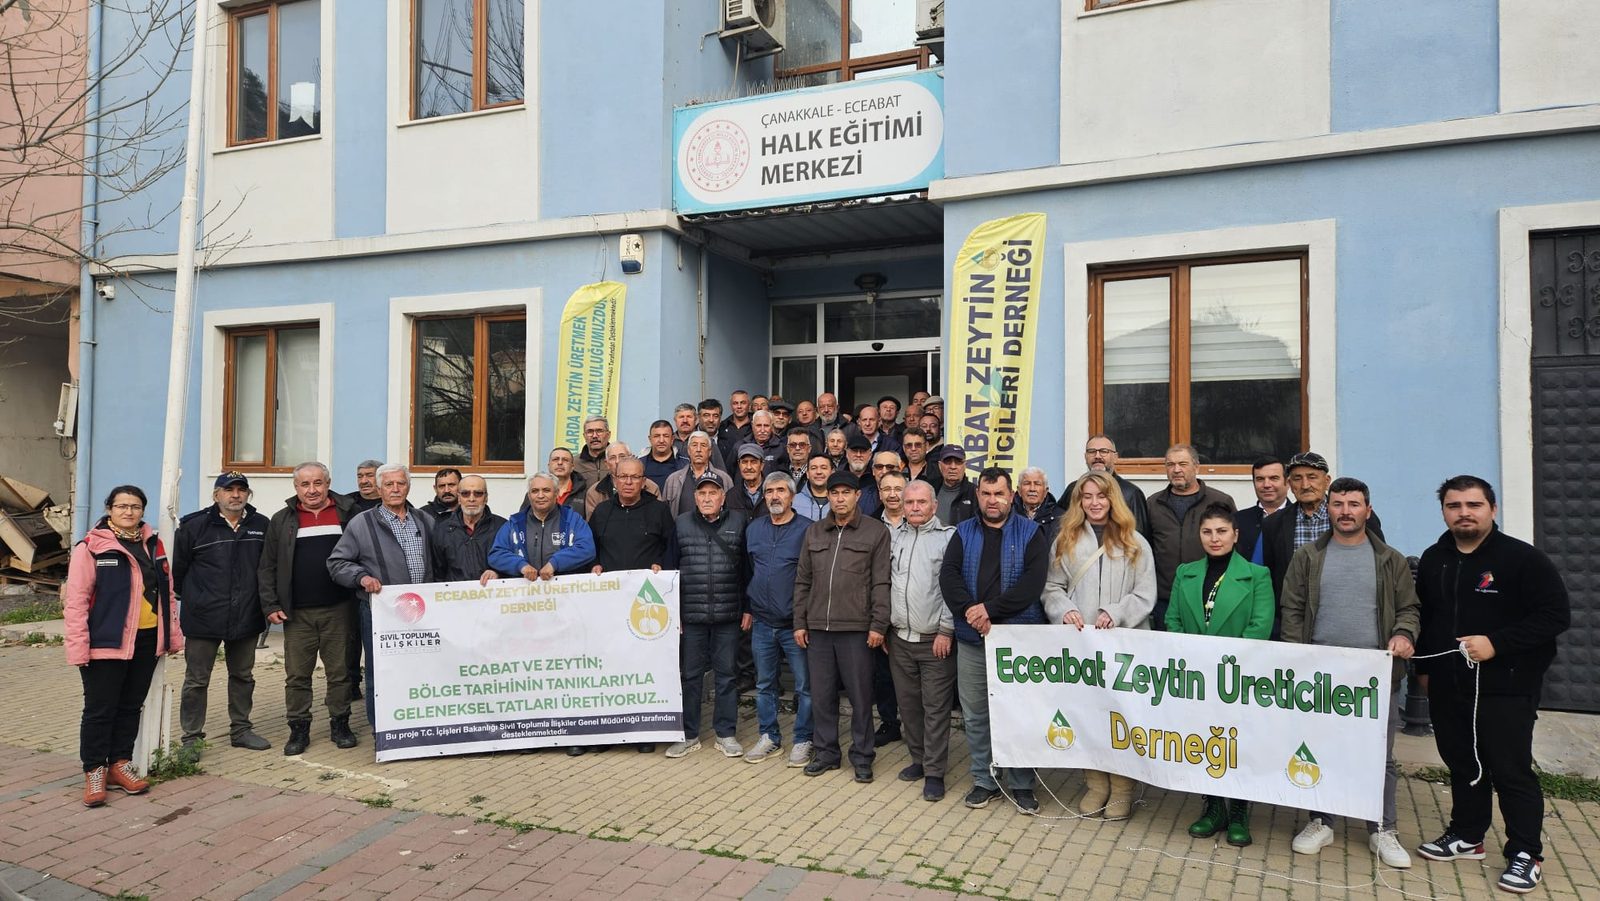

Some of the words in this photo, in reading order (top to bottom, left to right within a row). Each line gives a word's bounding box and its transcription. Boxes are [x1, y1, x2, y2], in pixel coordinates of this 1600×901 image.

[761, 104, 834, 128] ÇANAKKALE
[844, 94, 902, 115] ECEABAT
[761, 129, 823, 156] HALK
[829, 110, 922, 148] EĞİTİMİ
[761, 149, 862, 185] MERKEZİ
[1001, 239, 1033, 356] DERNEĞİ
[568, 315, 587, 369] ÜRETMEK
[963, 274, 995, 386] ZEYTİN
[587, 298, 607, 417] ORUMLULUĞUMUZDU
[566, 372, 583, 413] ZEYTİN
[566, 415, 580, 454] LARDA
[434, 588, 495, 602] ECEABAT
[495, 583, 541, 598] ZEYTİN
[543, 577, 620, 595] ÜRETİCİLERİ
[500, 598, 557, 614] DERNEĞİ
[380, 639, 441, 649] İLİŞKİLER
[401, 632, 440, 640] TOPLUMLA
[459, 661, 520, 677] ECABAT
[522, 658, 543, 672] VE
[545, 654, 603, 671] ZEYTİN;
[995, 647, 1106, 688] Eceabat
[1112, 653, 1205, 706] Zeytin
[1217, 654, 1379, 719] Üreticileri
[409, 683, 461, 700] BÖLGE
[464, 676, 543, 696] TARİHİNİN
[546, 672, 655, 690] TANIKLARIYLA
[393, 702, 494, 721] GELENEKSEL
[496, 698, 558, 714] TATLARI
[562, 692, 669, 709] ÜRETİYORUZ...
[385, 732, 397, 741] Bu
[398, 731, 419, 741] proje
[420, 728, 435, 737] T.C.
[436, 727, 461, 737] İçişleri
[463, 725, 498, 734] Bakanlığı
[499, 722, 516, 731] Sivil
[516, 719, 550, 730] Toplumla
[550, 718, 577, 729] İlişkiler
[578, 719, 599, 727] Genel
[601, 716, 640, 726] Müdürlüğü
[641, 714, 676, 723] tarafından
[501, 729, 568, 739] desteklenmektedir.
[1109, 711, 1238, 779] Derneği
